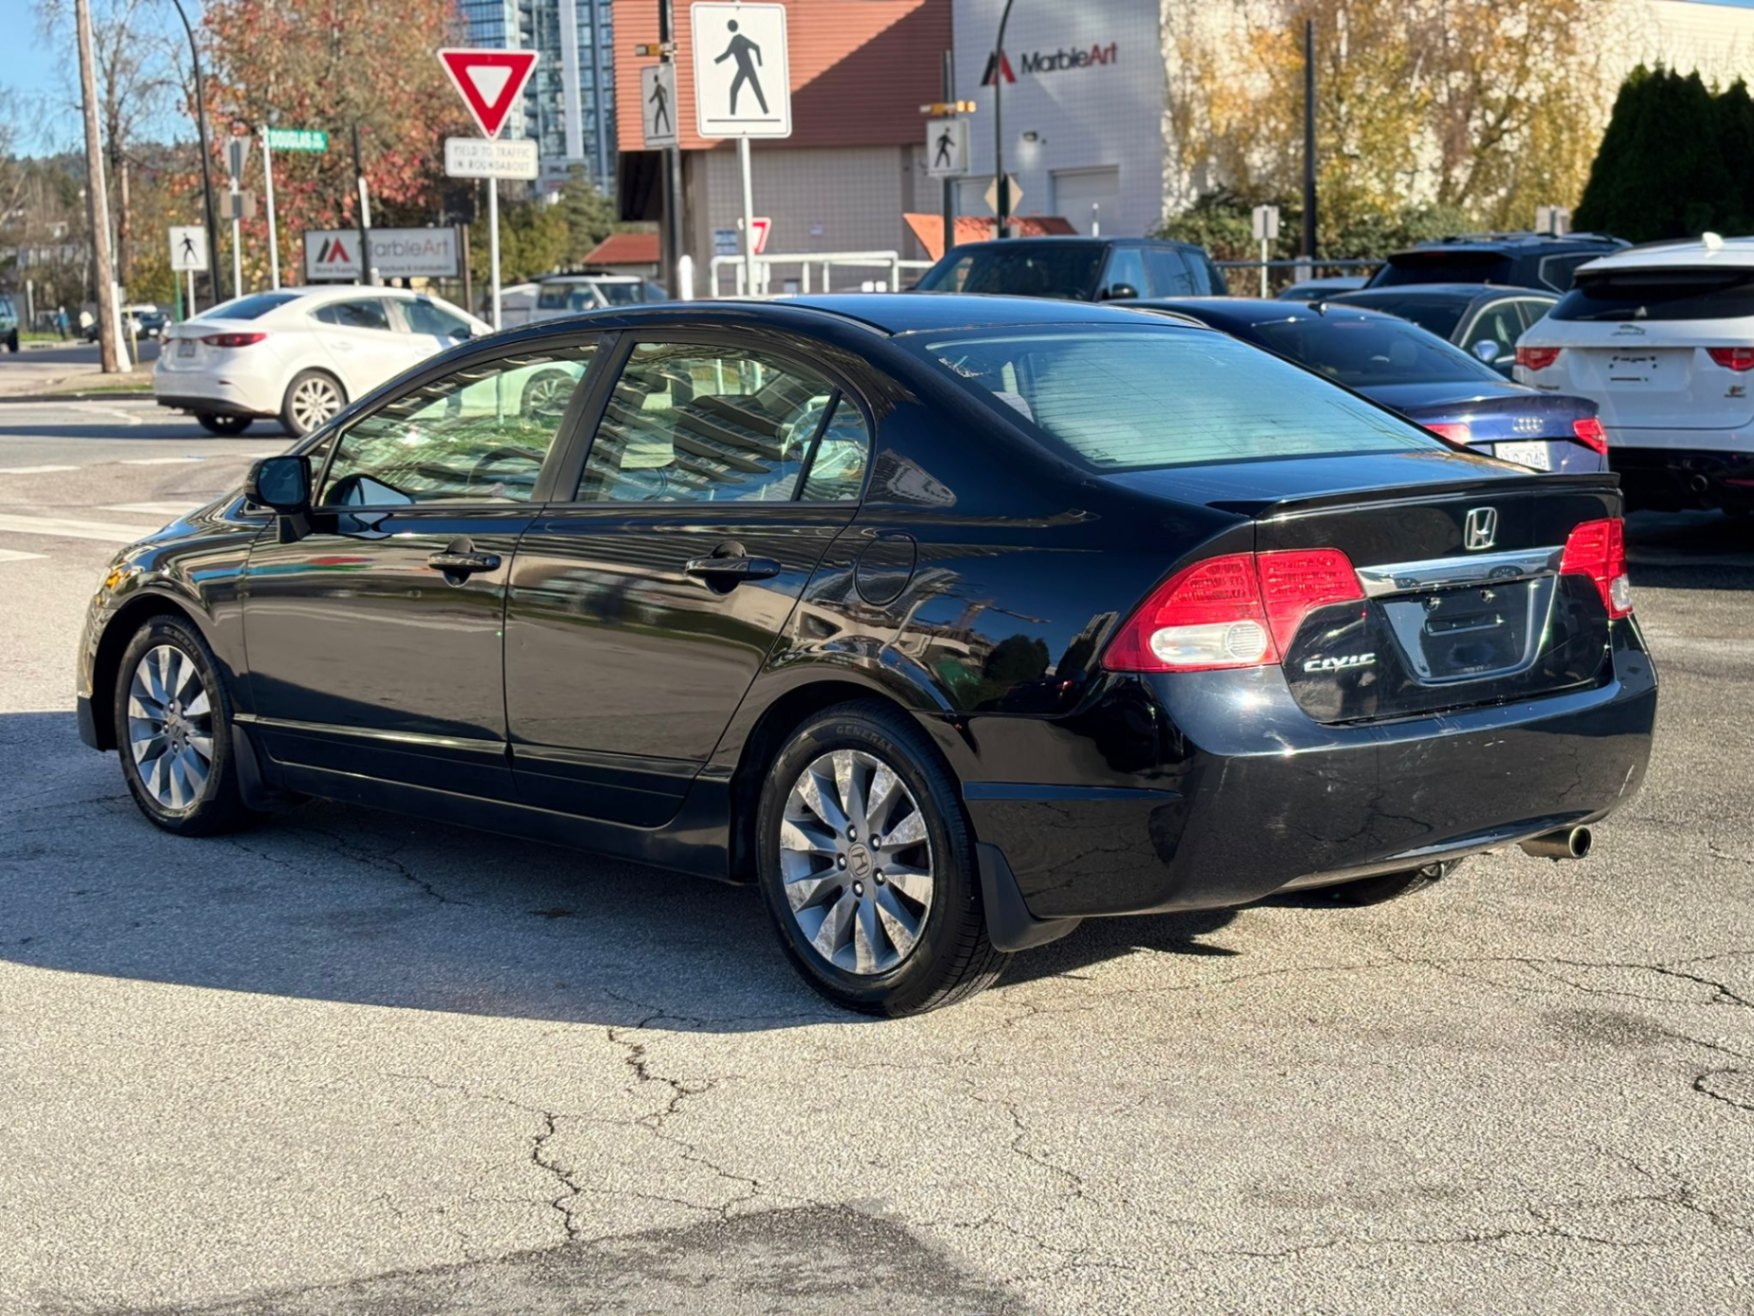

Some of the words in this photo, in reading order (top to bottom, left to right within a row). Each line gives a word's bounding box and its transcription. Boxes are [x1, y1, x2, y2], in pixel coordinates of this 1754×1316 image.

[1021, 41, 1117, 75] MarbleArt
[454, 146, 478, 156] YIELD
[482, 147, 491, 157] TO
[496, 147, 531, 158] TRAFFIC
[454, 161, 464, 170] IN
[469, 161, 530, 171] ROUNDABOUT
[1304, 653, 1376, 672] CIVIC
[836, 725, 893, 752] GENERAL
